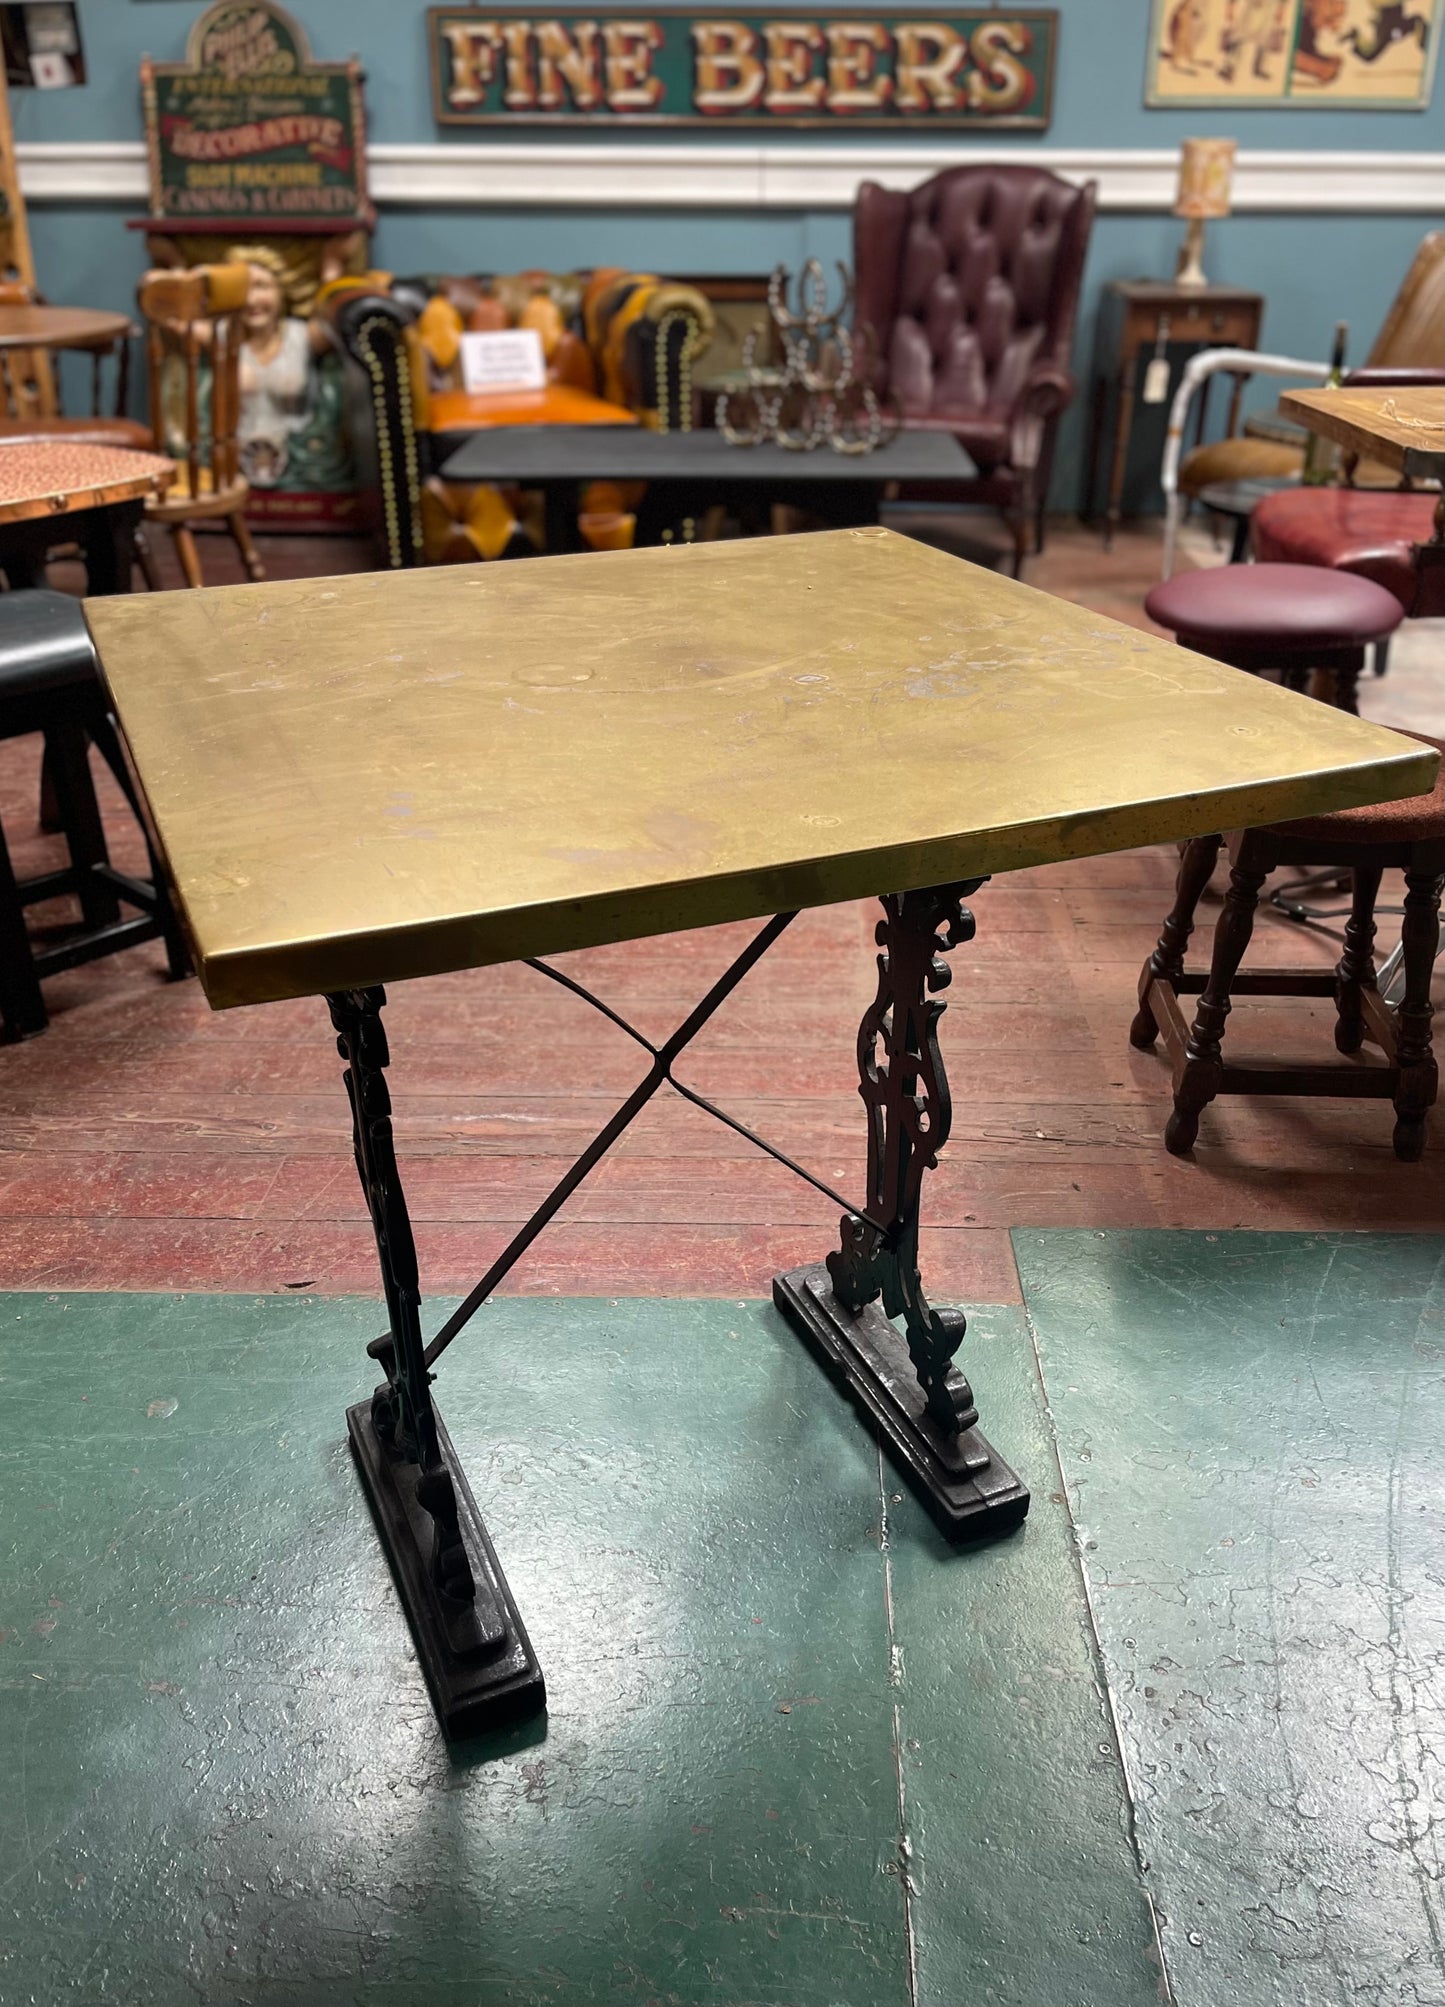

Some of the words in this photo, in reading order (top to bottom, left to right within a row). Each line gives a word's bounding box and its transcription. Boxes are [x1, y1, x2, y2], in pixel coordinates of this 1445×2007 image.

[443, 20, 664, 109] FINE
[691, 21, 1034, 113] BEERS
[170, 115, 344, 157] DECORATIVE
[234, 163, 322, 186] MACHINE
